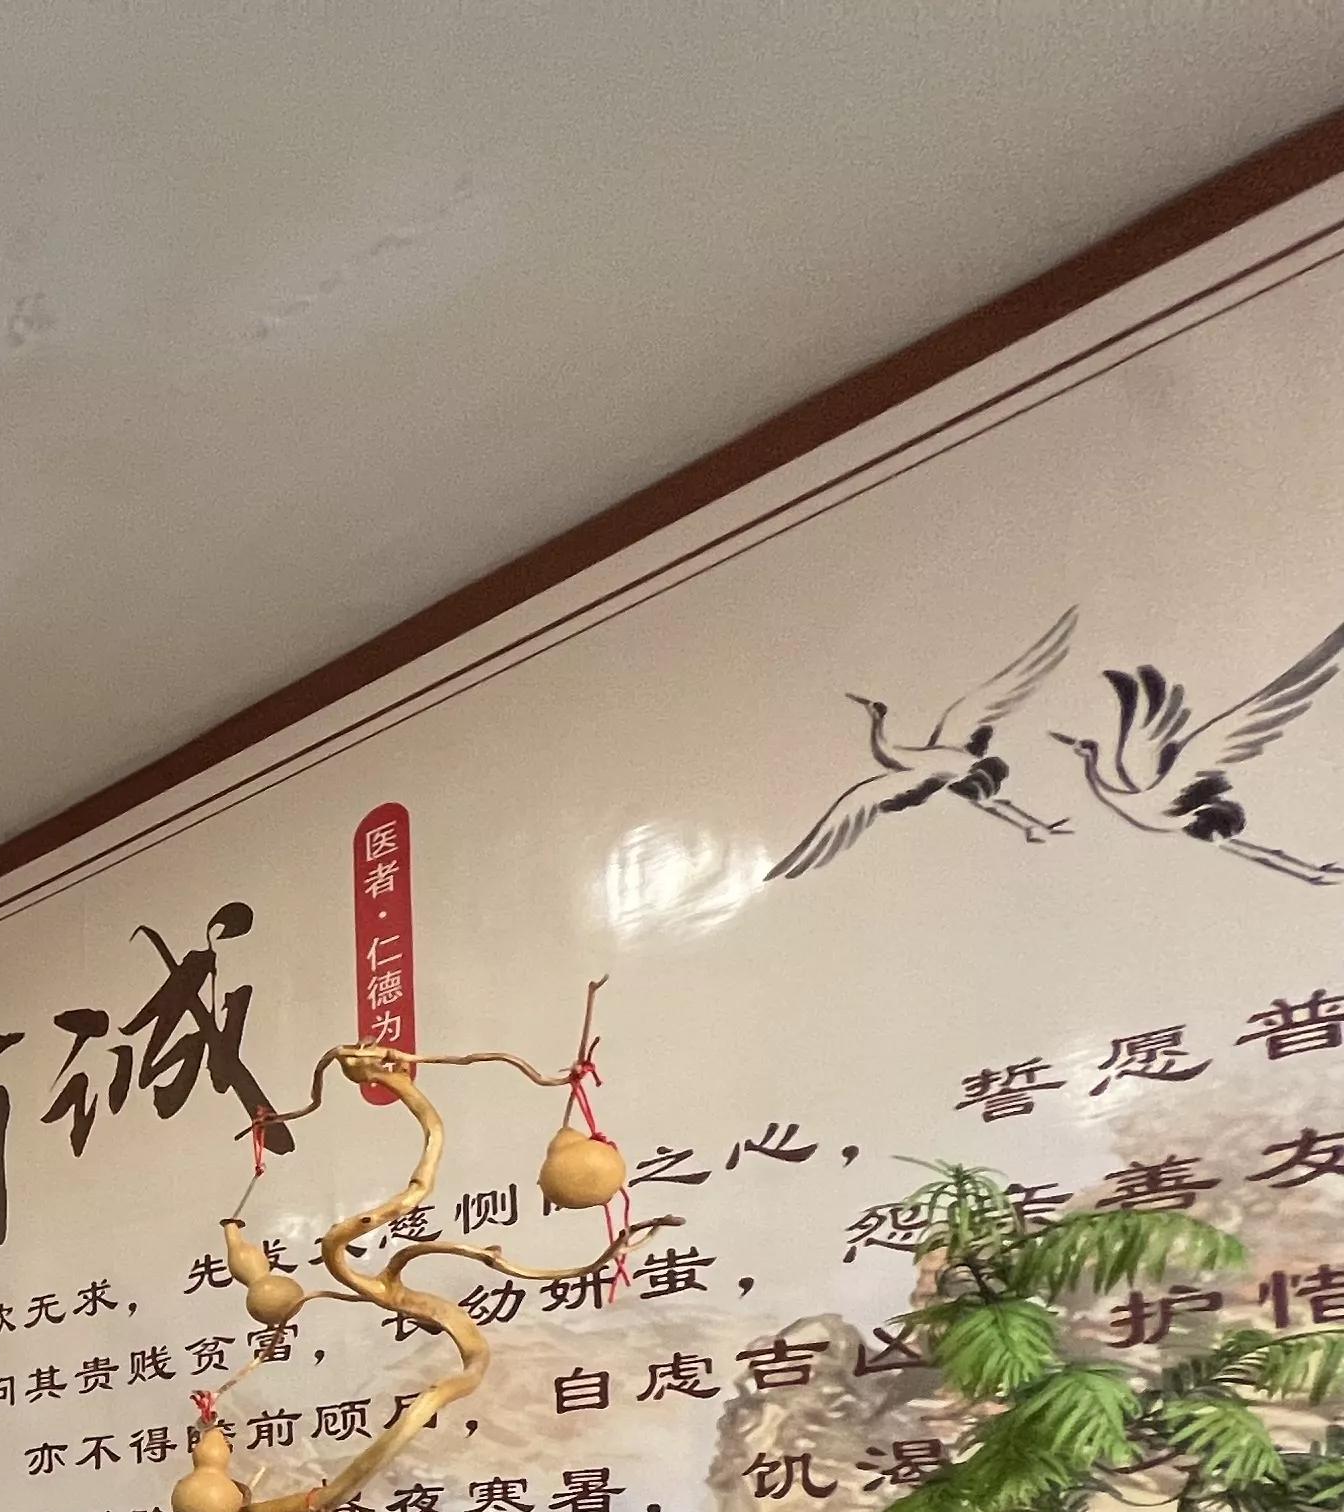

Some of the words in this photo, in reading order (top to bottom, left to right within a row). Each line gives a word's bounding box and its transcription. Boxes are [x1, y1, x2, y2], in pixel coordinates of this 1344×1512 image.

[364, 820, 404, 1087] 医者·仁德为
